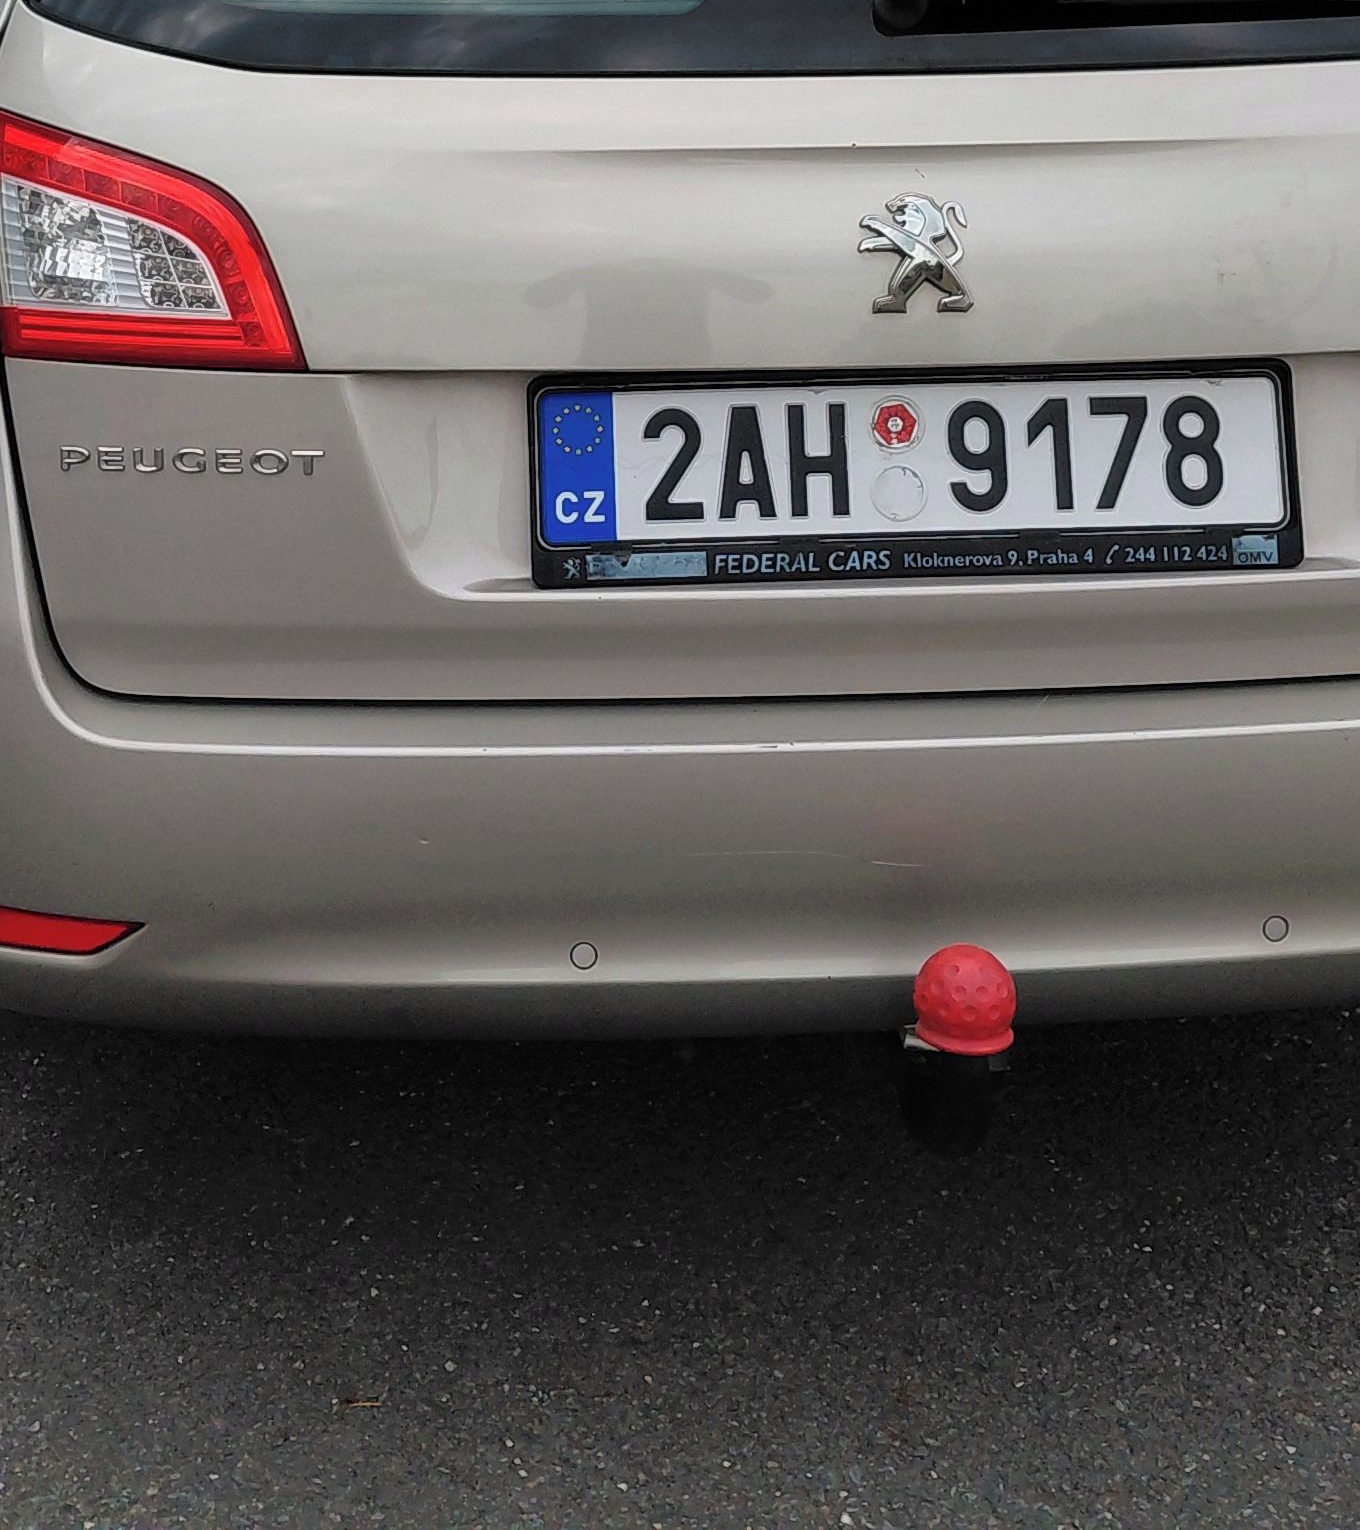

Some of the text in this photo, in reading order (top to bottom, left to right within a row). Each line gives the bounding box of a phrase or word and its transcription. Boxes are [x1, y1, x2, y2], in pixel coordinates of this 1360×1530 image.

[59, 444, 327, 476] PEUGEOT
[642, 395, 1225, 522] 2AH 9178
[554, 490, 607, 524] CZ
[714, 552, 821, 575] FEDERAL
[827, 549, 892, 572] CARS
[903, 551, 1003, 568] Kloknerova
[1027, 548, 1079, 566] Praha
[1083, 547, 1094, 563] 4
[1124, 546, 1156, 563] 244
[1163, 545, 1193, 562] 112
[1196, 544, 1228, 561] 424
